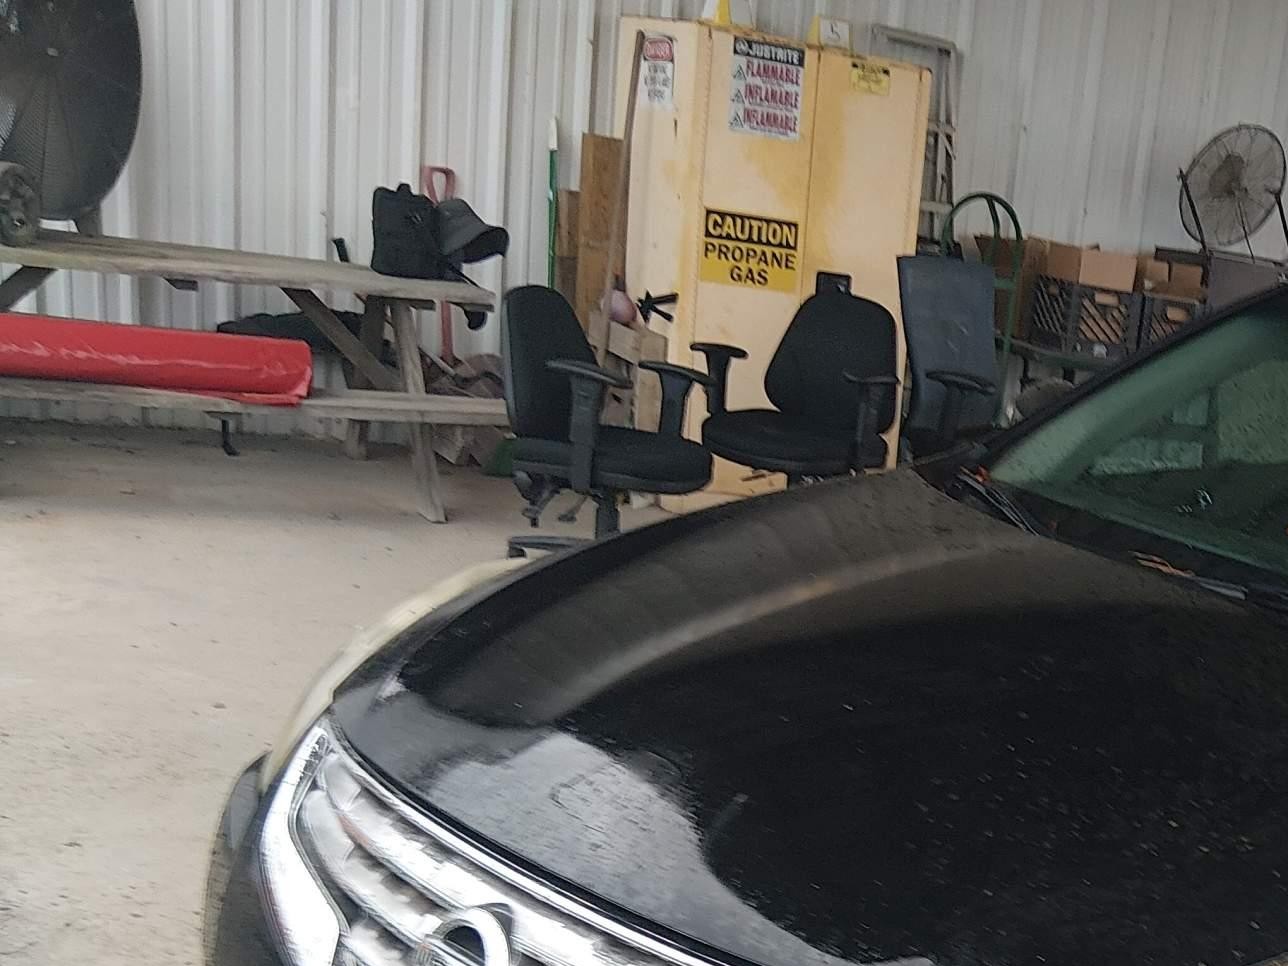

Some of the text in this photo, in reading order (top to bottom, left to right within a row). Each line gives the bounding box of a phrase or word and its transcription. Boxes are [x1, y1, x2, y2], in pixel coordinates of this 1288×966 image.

[749, 42, 800, 65] JUSTRITE
[746, 59, 800, 86] FLAMMABLE
[707, 213, 796, 248] CAUTION
[704, 241, 797, 271] PROPANE
[730, 265, 769, 286] GAS
